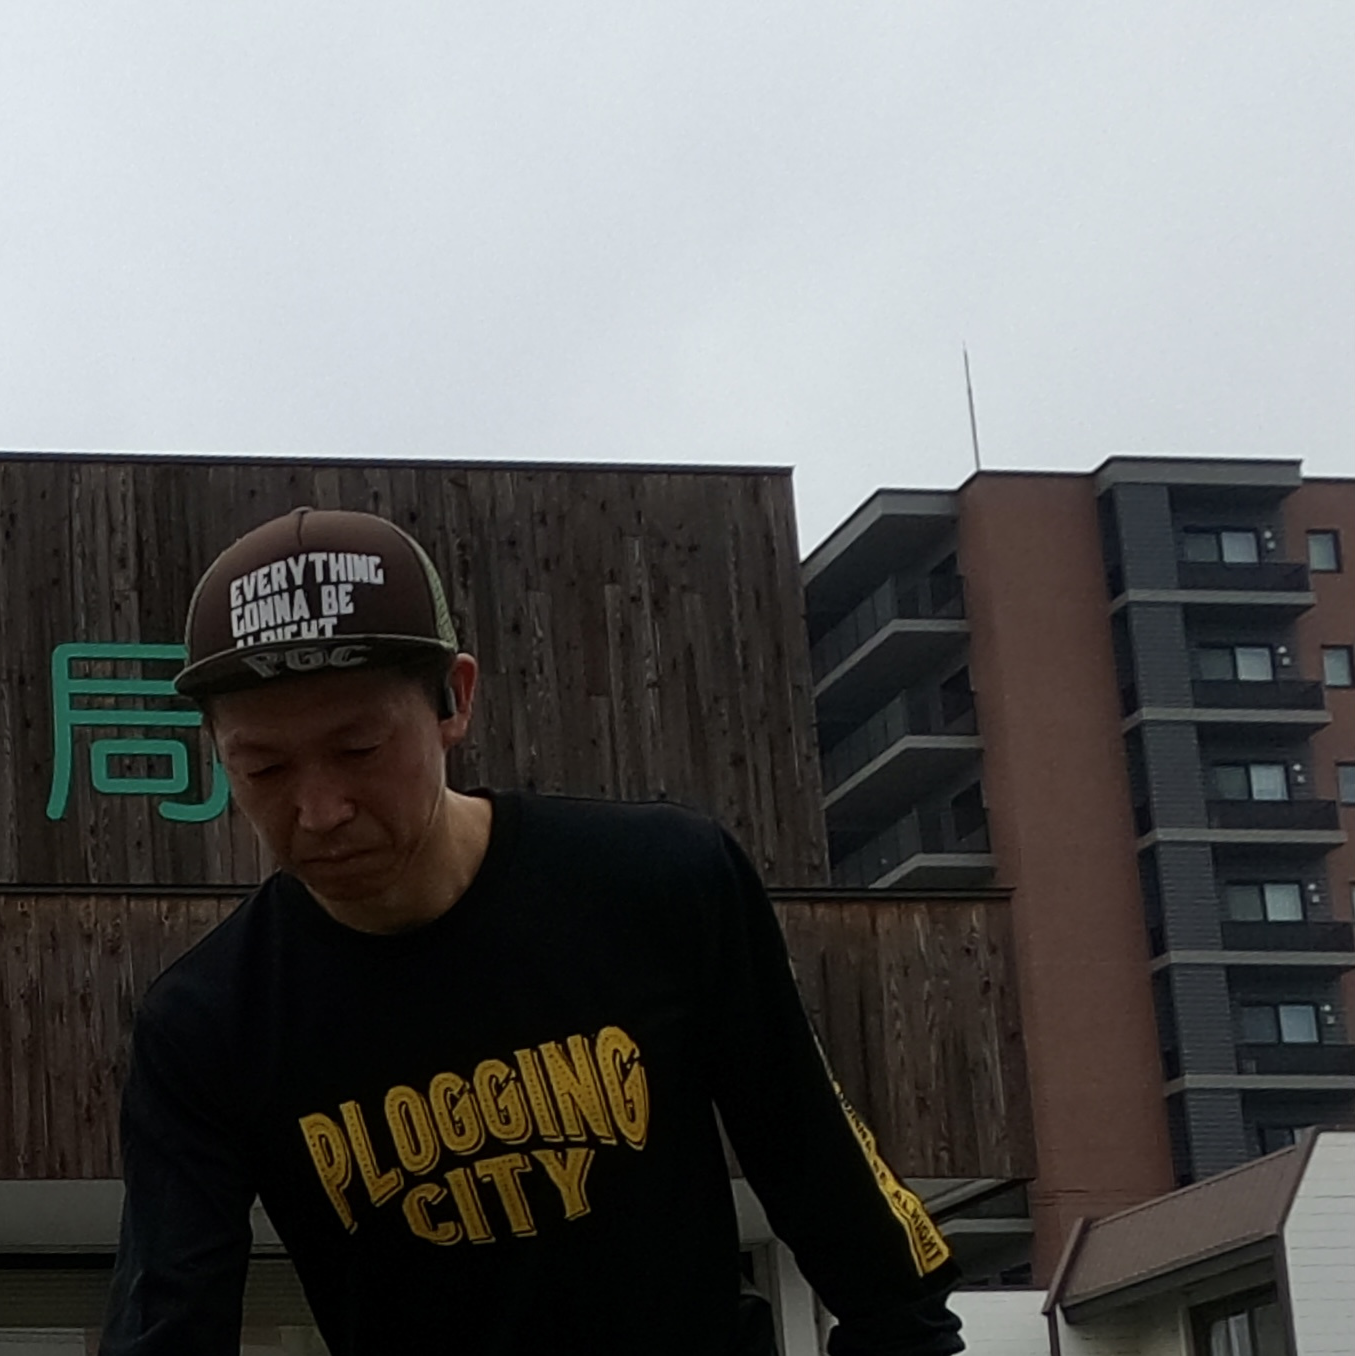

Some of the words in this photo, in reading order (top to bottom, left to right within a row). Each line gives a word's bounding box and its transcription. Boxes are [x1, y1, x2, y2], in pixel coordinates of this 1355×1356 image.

[230, 552, 384, 608] EVERYTHING
[231, 589, 310, 638] GONNA
[321, 584, 354, 615] BE
[299, 1026, 649, 1234] PLOGGING
[402, 1147, 595, 1245] CITY
